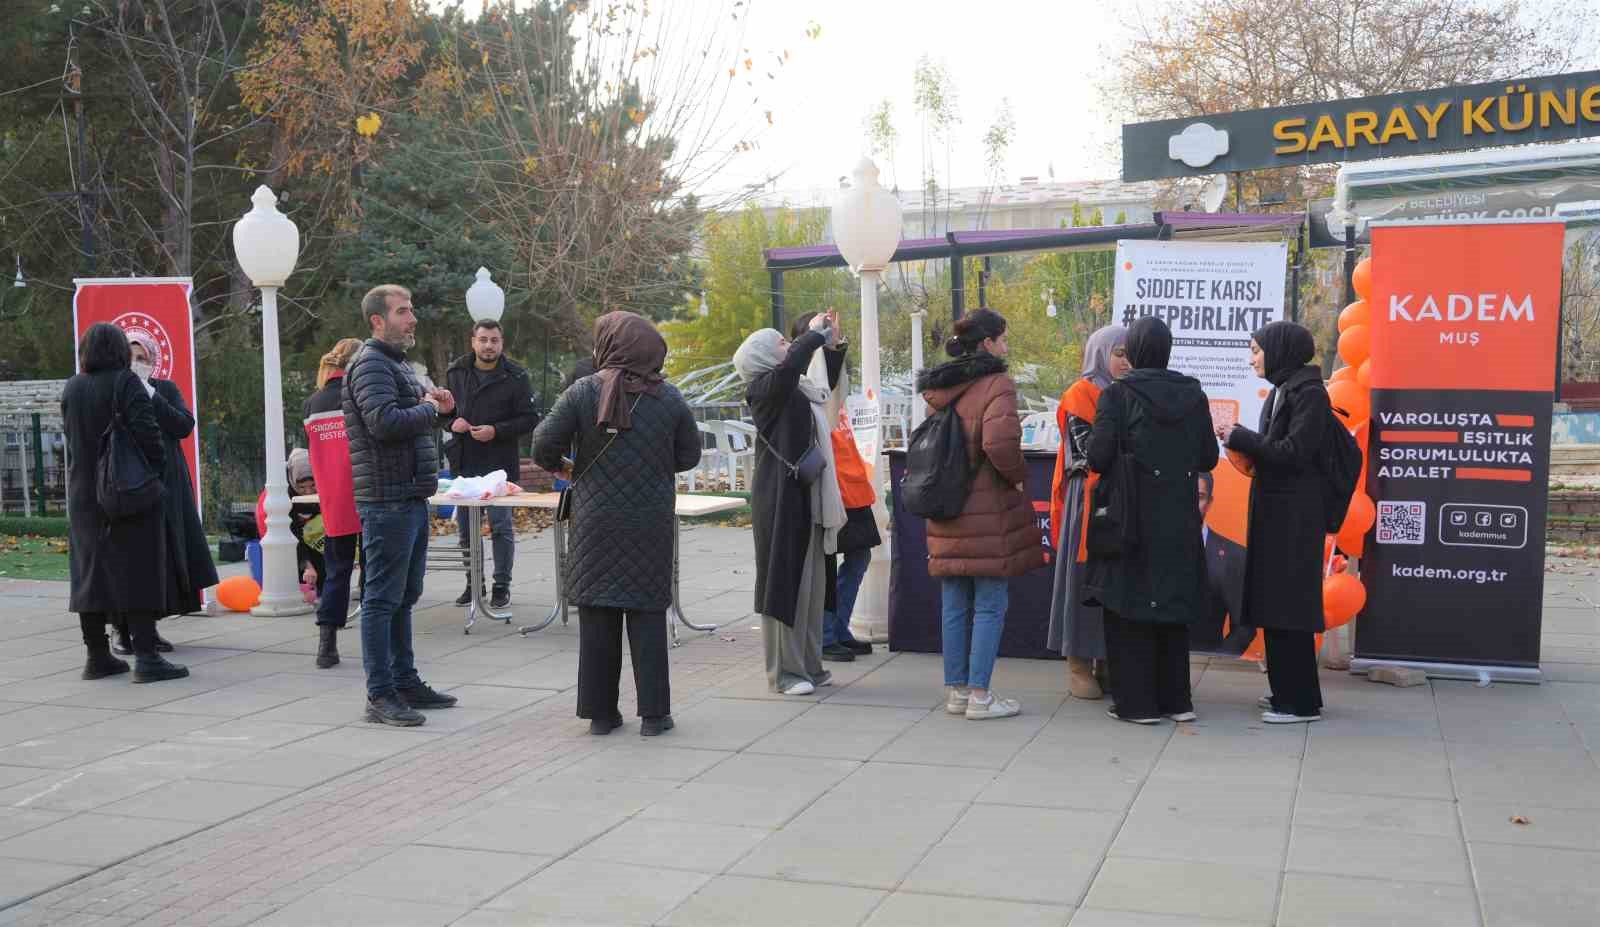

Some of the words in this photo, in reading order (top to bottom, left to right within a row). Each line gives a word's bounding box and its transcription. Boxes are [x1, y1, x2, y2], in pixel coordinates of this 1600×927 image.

[1273, 102, 1451, 154] SARAY
[1136, 278, 1205, 300] ŞİDDETE
[1211, 280, 1262, 302] KARŞI
[1389, 294, 1535, 321] KADEM
[1439, 332, 1480, 346] MUŞ
[1379, 412, 1493, 426] VAROLUŞTA
[1463, 431, 1534, 446] EŞİTLİK
[1379, 448, 1533, 464] SORUMLULUKTA
[1377, 466, 1451, 479] ADALET
[1458, 530, 1507, 540] kademmus
[1392, 564, 1508, 583] kadem.org.tr
